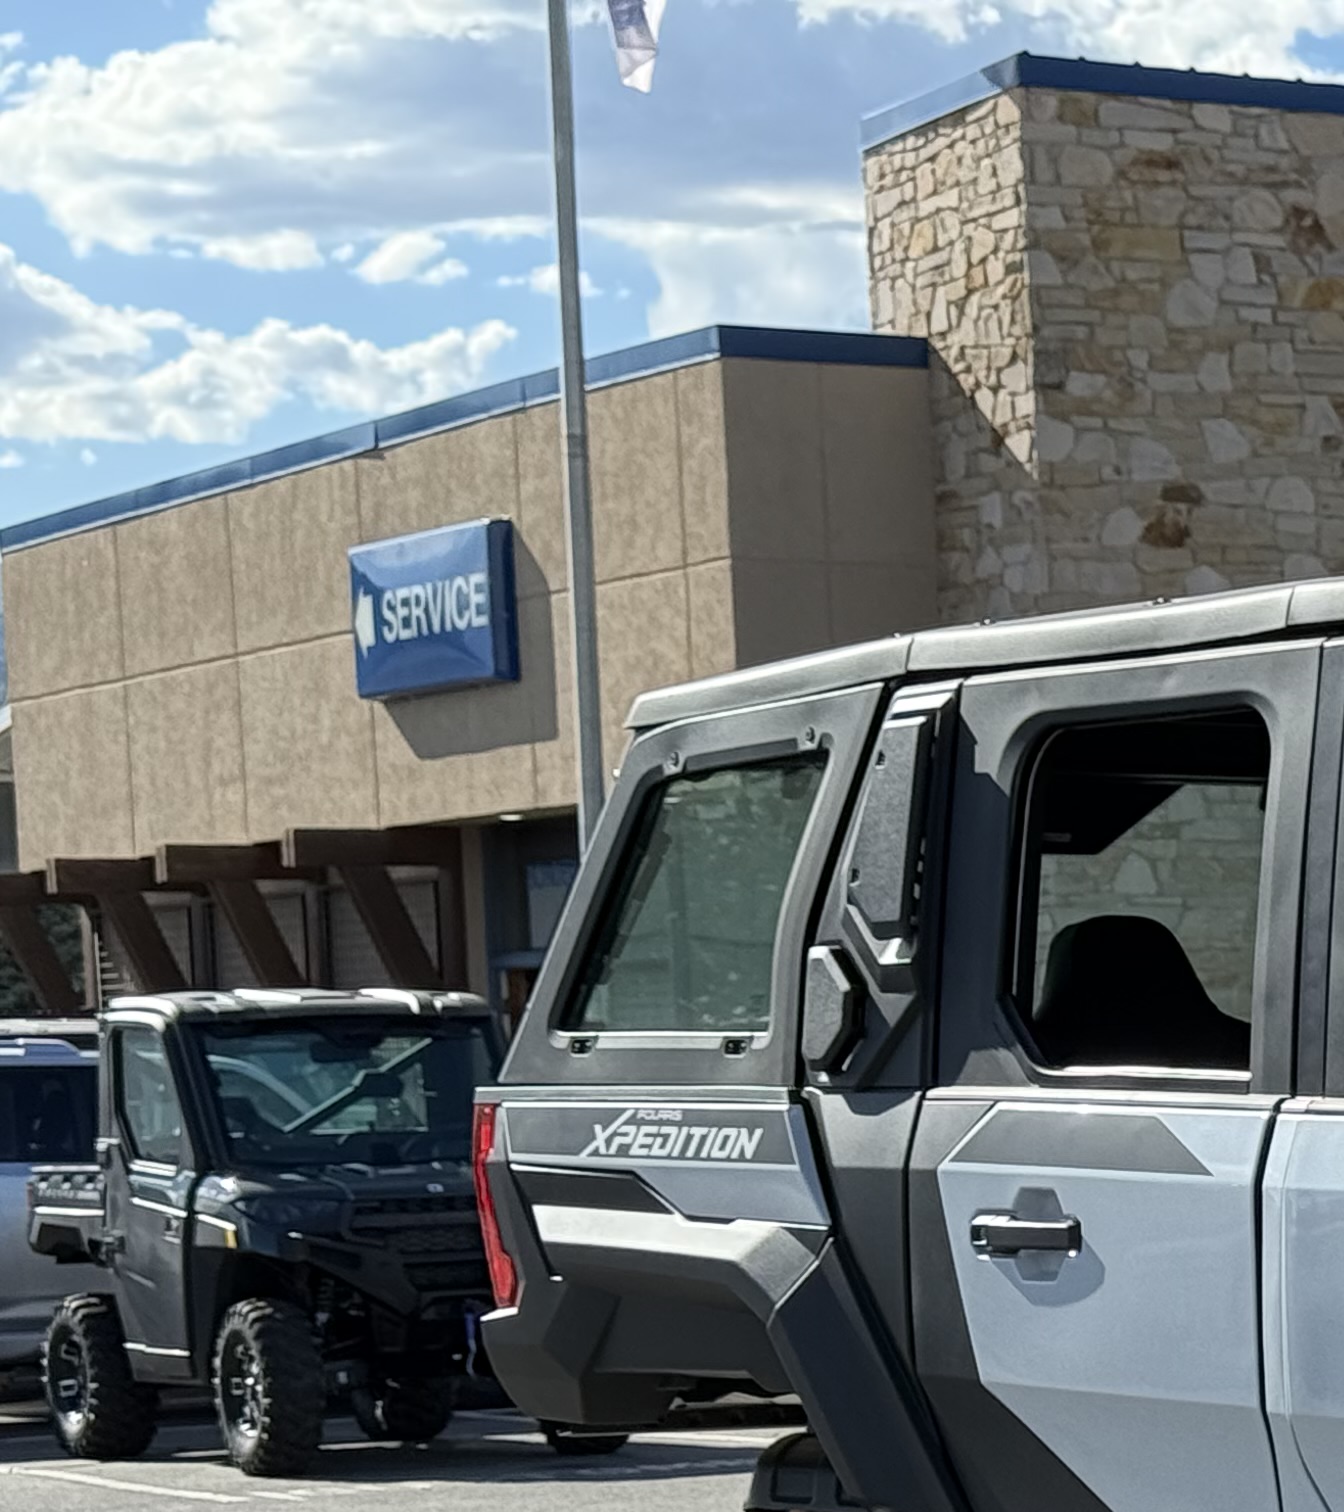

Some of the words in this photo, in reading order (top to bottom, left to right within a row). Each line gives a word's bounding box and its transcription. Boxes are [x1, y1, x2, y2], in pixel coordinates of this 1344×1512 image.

[381, 571, 490, 644] SERVICE
[578, 1108, 764, 1159] XPEDITION
[636, 1109, 683, 1121] POLARIS
